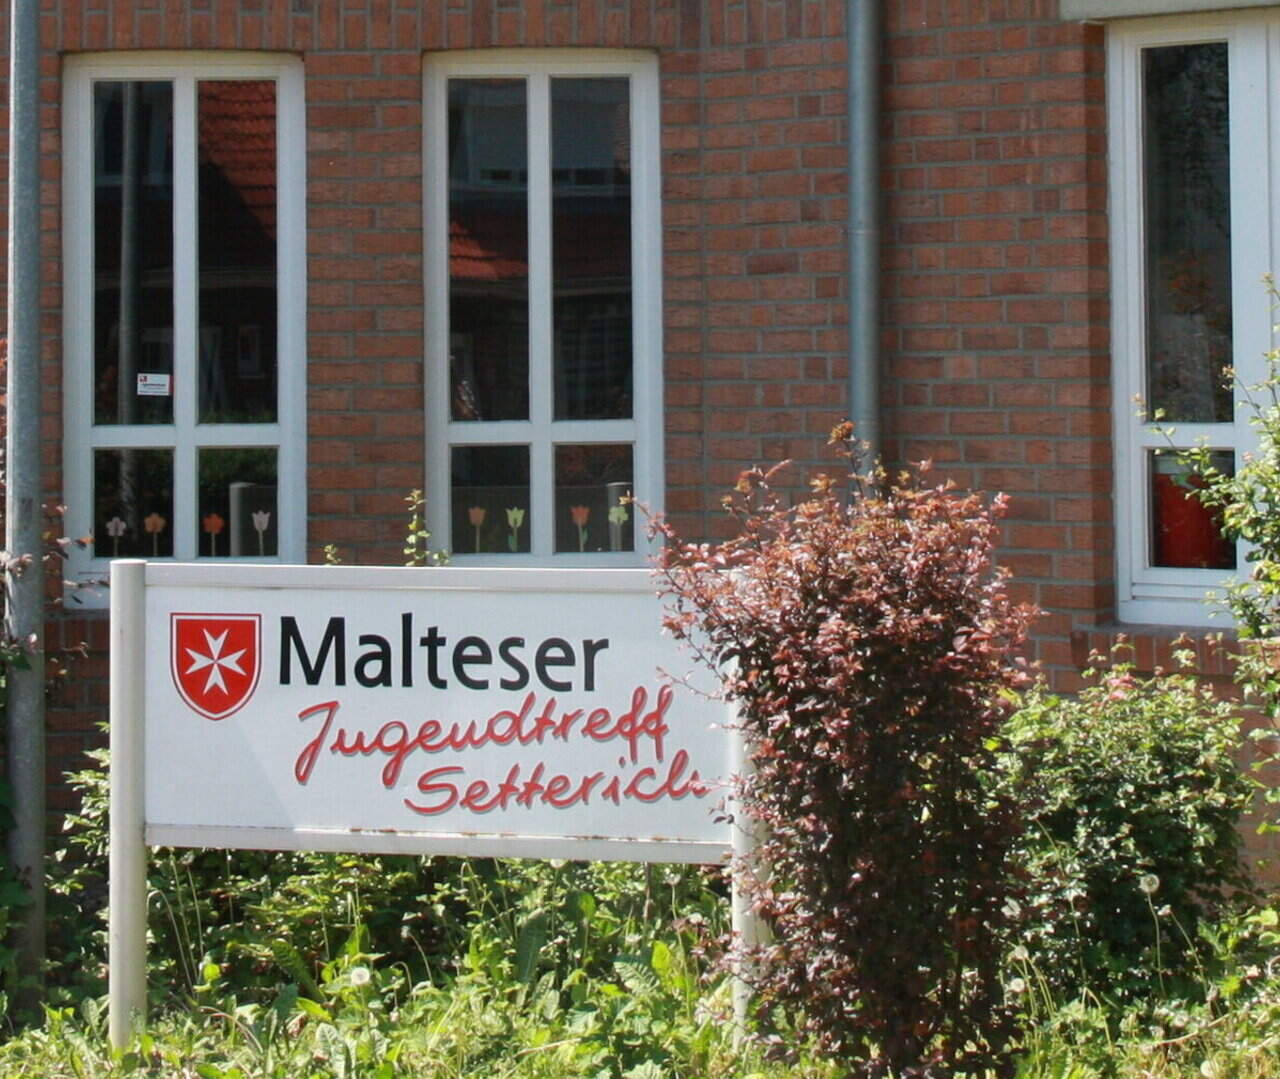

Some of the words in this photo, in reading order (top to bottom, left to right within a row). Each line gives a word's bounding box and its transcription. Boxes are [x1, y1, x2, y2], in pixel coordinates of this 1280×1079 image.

[279, 611, 609, 692] Malteser
[294, 685, 673, 786] Jugendtreff
[403, 749, 711, 816] Setterich
